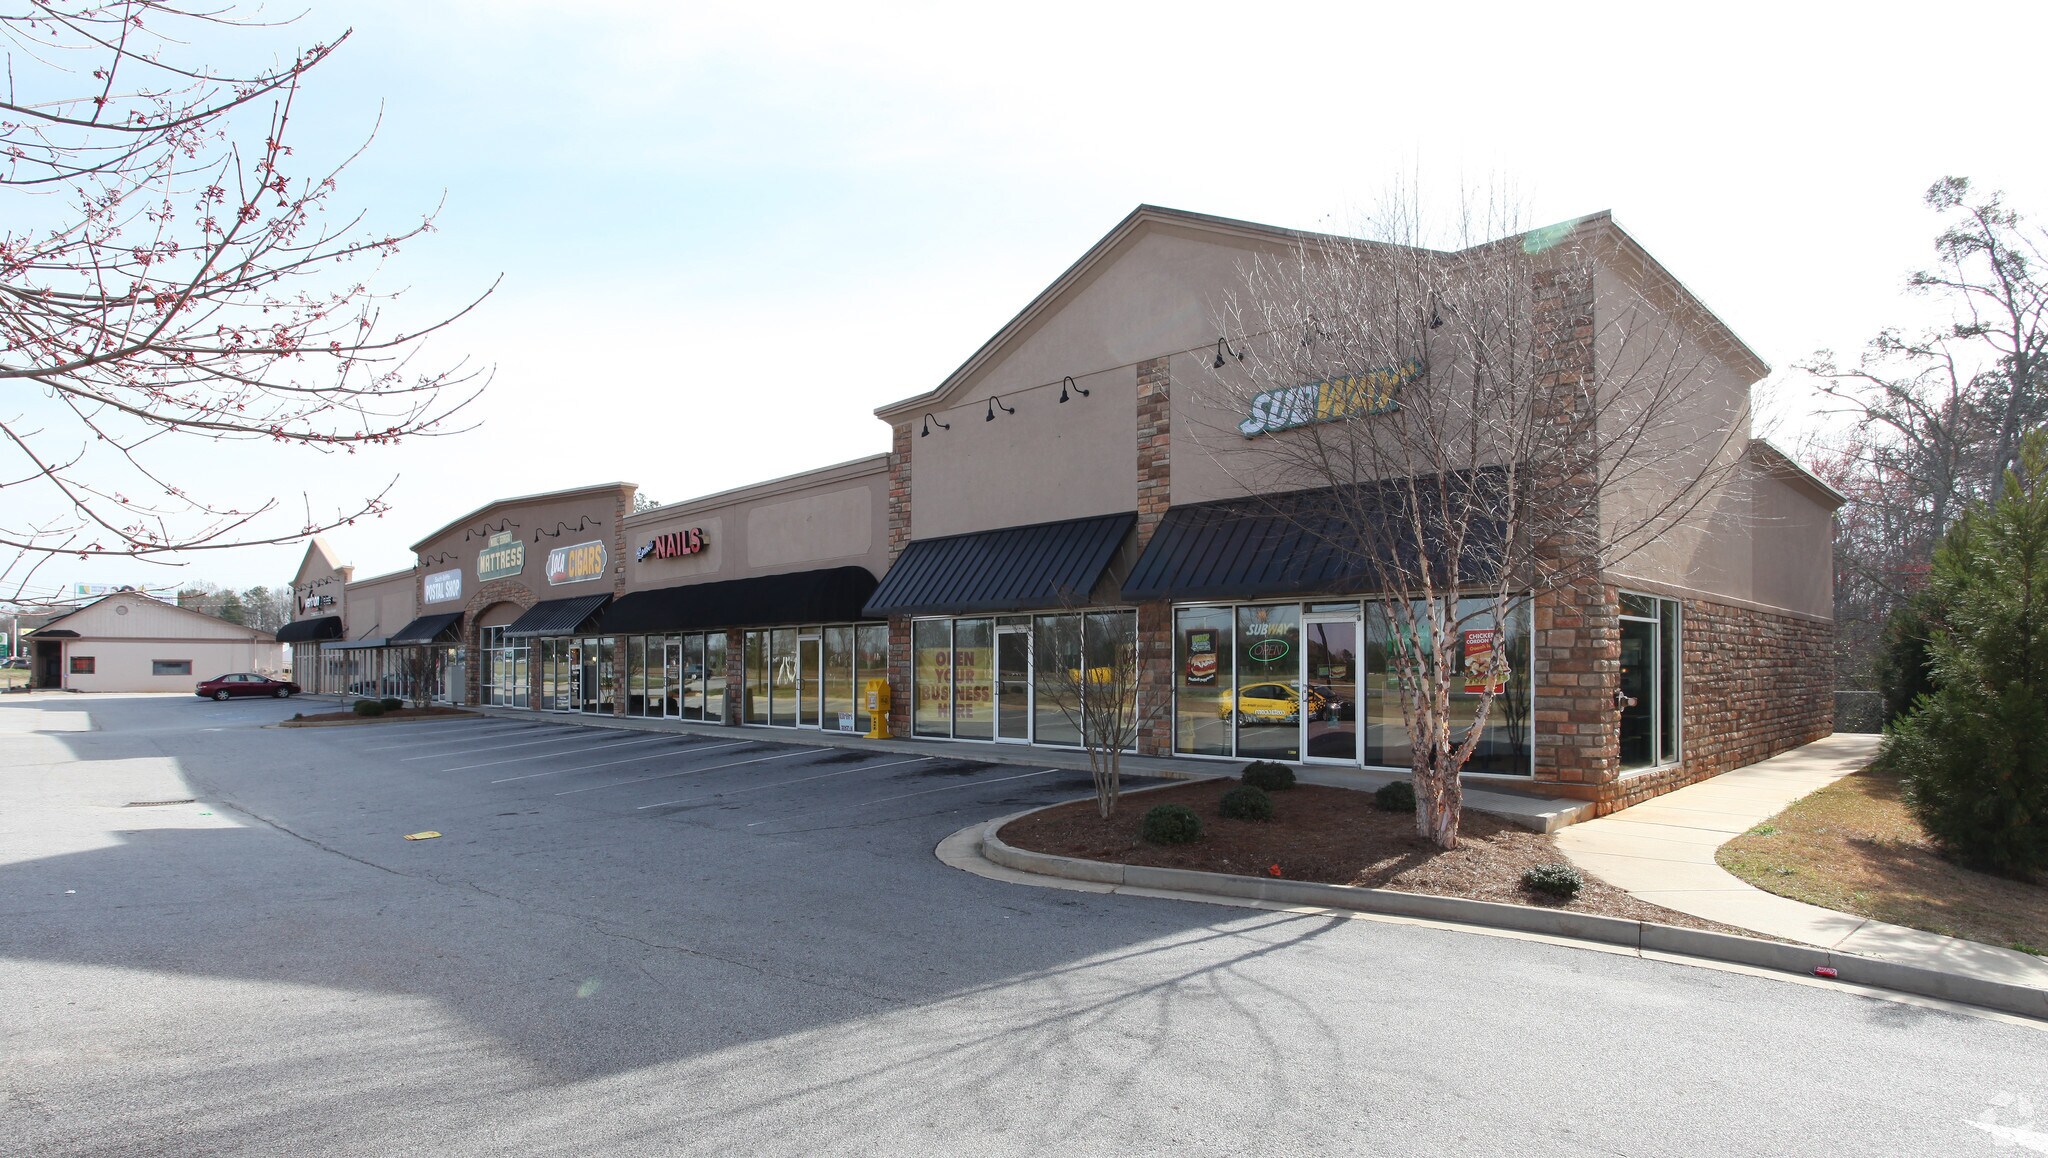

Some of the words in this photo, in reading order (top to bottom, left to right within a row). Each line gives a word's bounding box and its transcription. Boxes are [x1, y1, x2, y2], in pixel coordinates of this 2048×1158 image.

[1239, 360, 1422, 436] SUBWAY
[655, 526, 703, 560] NAILS
[479, 546, 522, 574] MATTRESS
[568, 544, 602, 578] CIGARS
[426, 582, 444, 601] POSTAL
[445, 579, 460, 598] SHOP
[1246, 623, 1290, 636] SUBWAY
[1254, 644, 1283, 656] OPEN
[921, 686, 990, 702] BUSNESS
[937, 703, 974, 719] HRE
